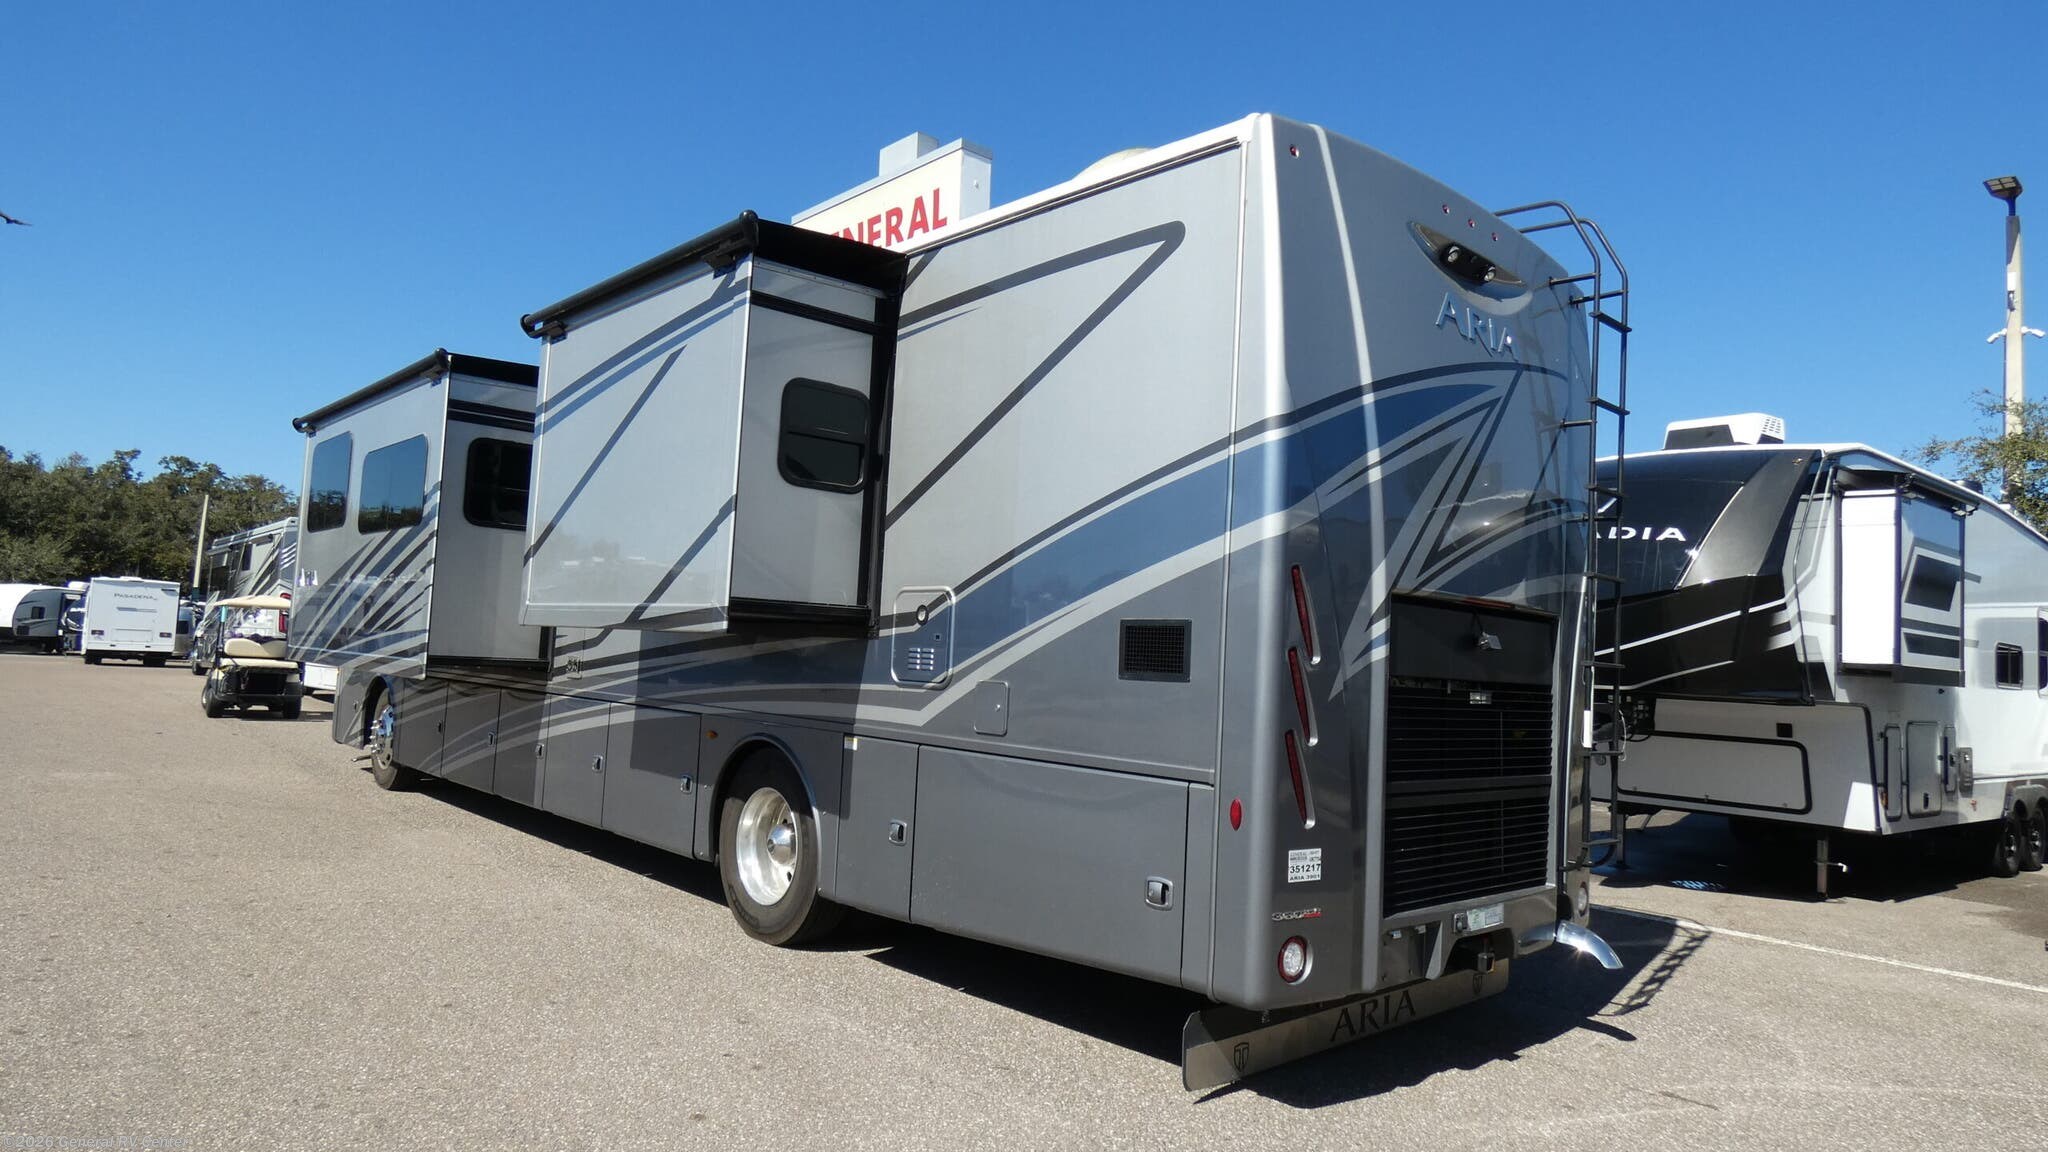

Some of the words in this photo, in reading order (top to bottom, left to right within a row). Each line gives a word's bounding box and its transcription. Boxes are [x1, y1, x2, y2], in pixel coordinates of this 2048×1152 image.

[1435, 292, 1521, 363] ARIA
[1289, 863, 1321, 874] 351217
[1330, 990, 1416, 1042] ARIA
